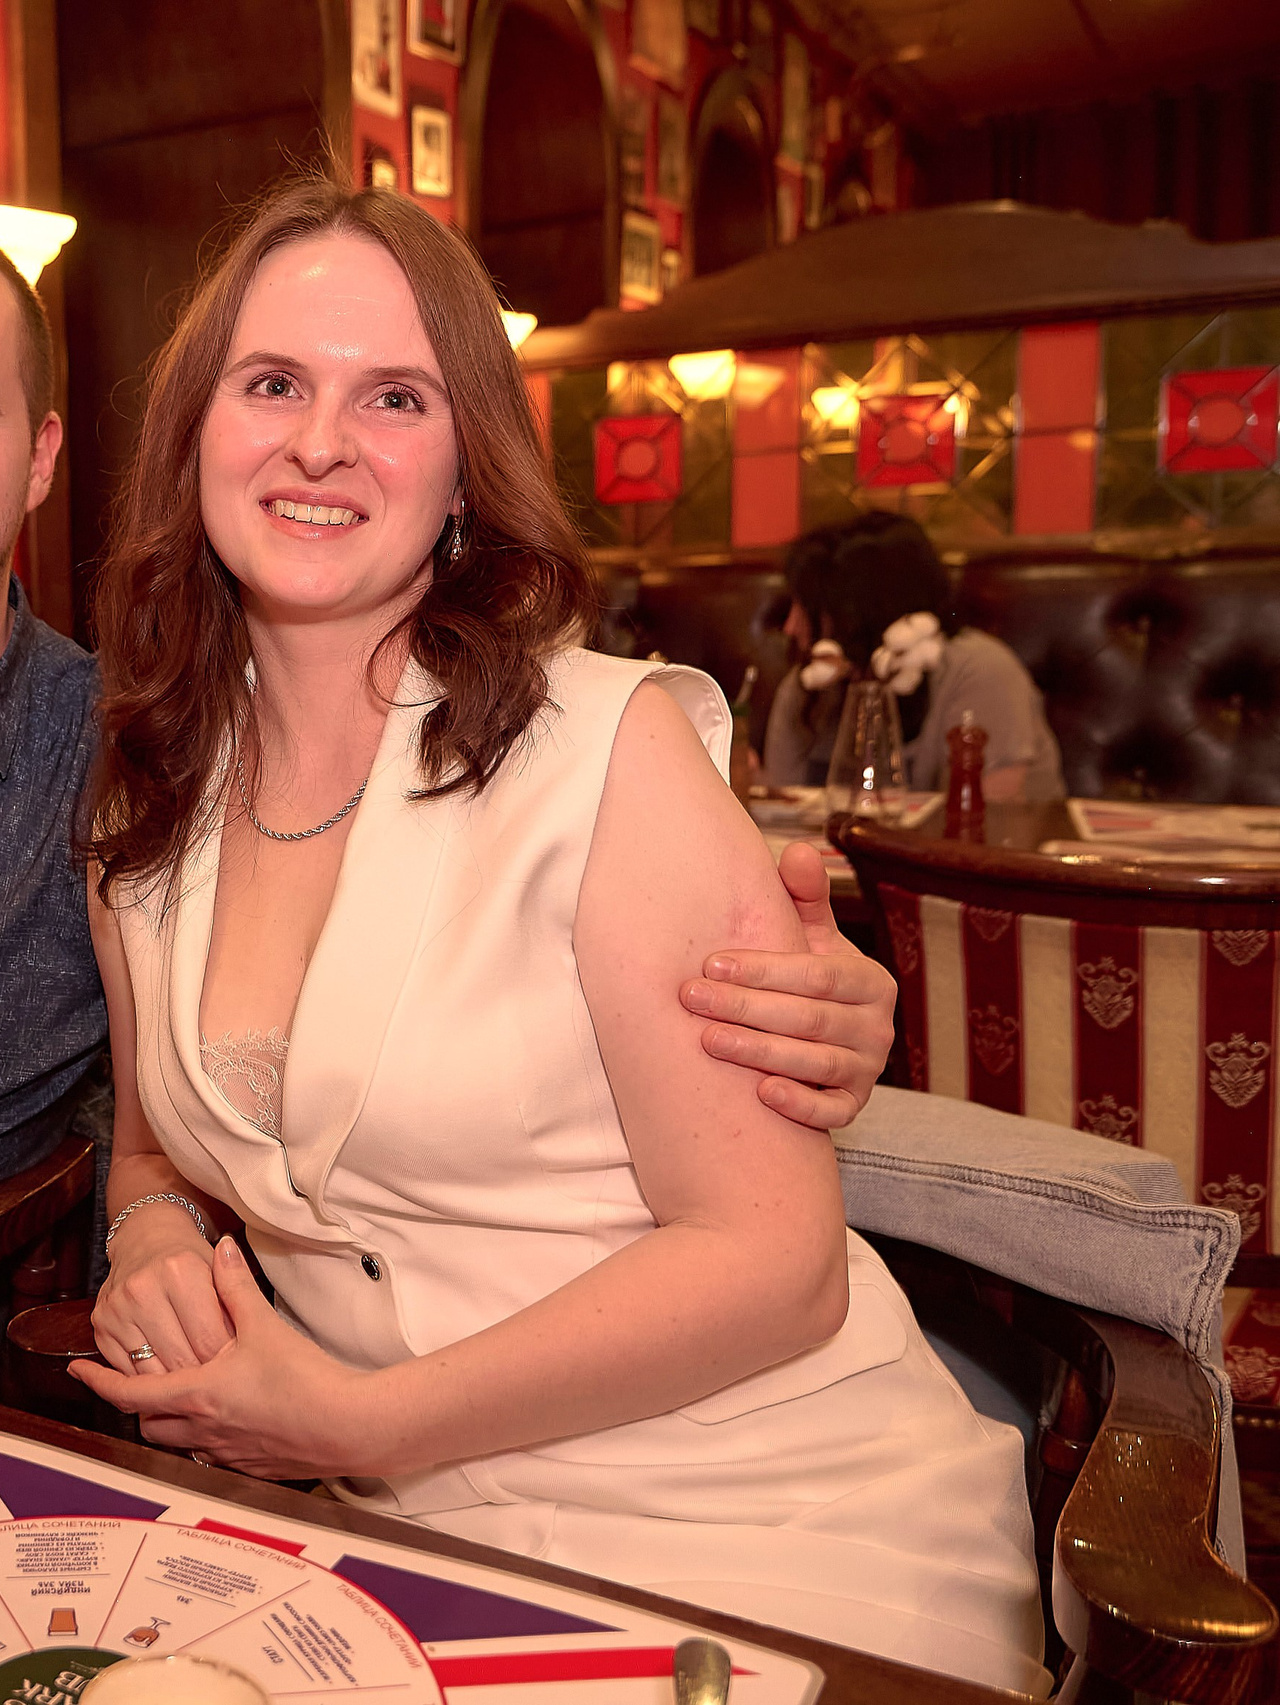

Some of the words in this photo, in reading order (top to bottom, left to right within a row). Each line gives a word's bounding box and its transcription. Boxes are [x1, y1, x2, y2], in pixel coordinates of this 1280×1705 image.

[177, 1528, 231, 1546] ТАБЛИЦА
[235, 1543, 307, 1570] СОЧЕТАНИЙ
[30, 1587, 90, 1595] ИНДИЙСКИЙ
[337, 1583, 377, 1617] ТАБЛИЦА
[375, 1617, 422, 1668] СОЧЕТАНИЙ
